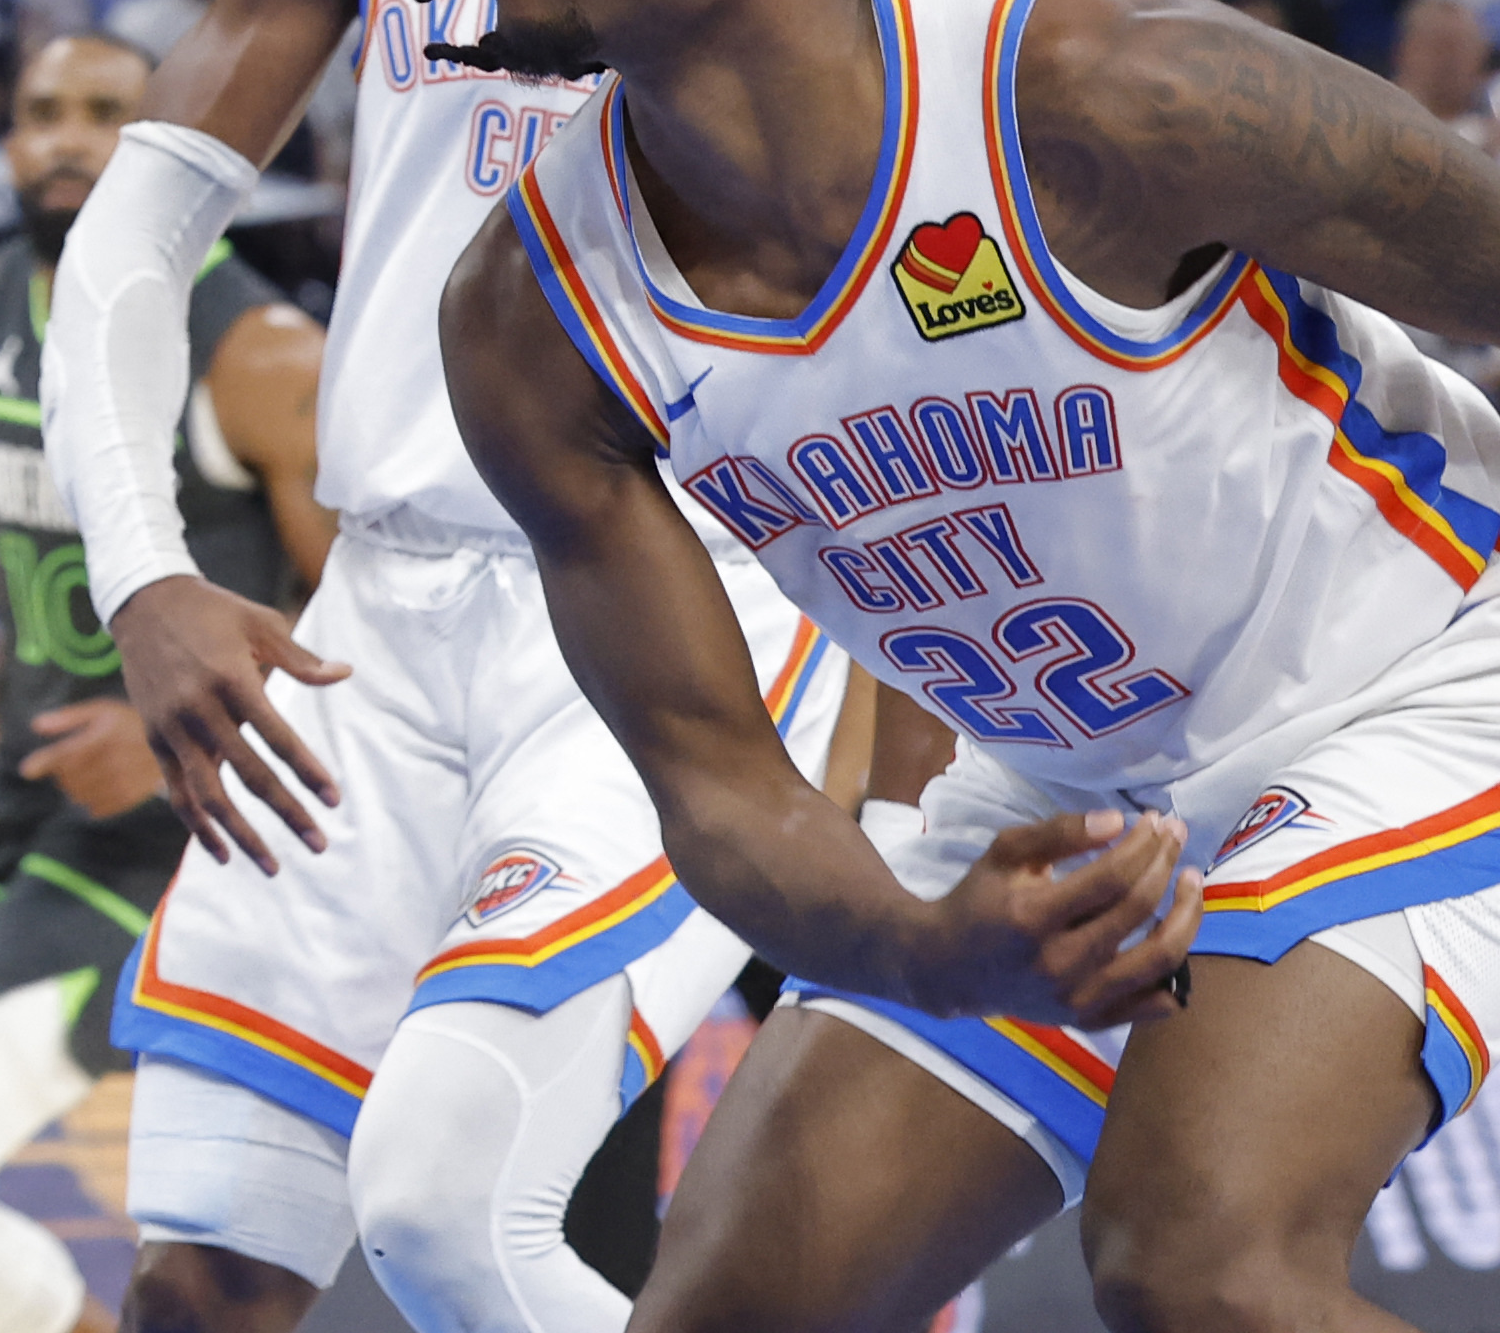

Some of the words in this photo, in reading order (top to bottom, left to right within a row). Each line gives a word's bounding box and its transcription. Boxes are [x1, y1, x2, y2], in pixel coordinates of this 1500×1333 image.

[682, 384, 1122, 552] KLAHOMA
[818, 503, 1044, 614] CITY
[879, 597, 1192, 750] 22
